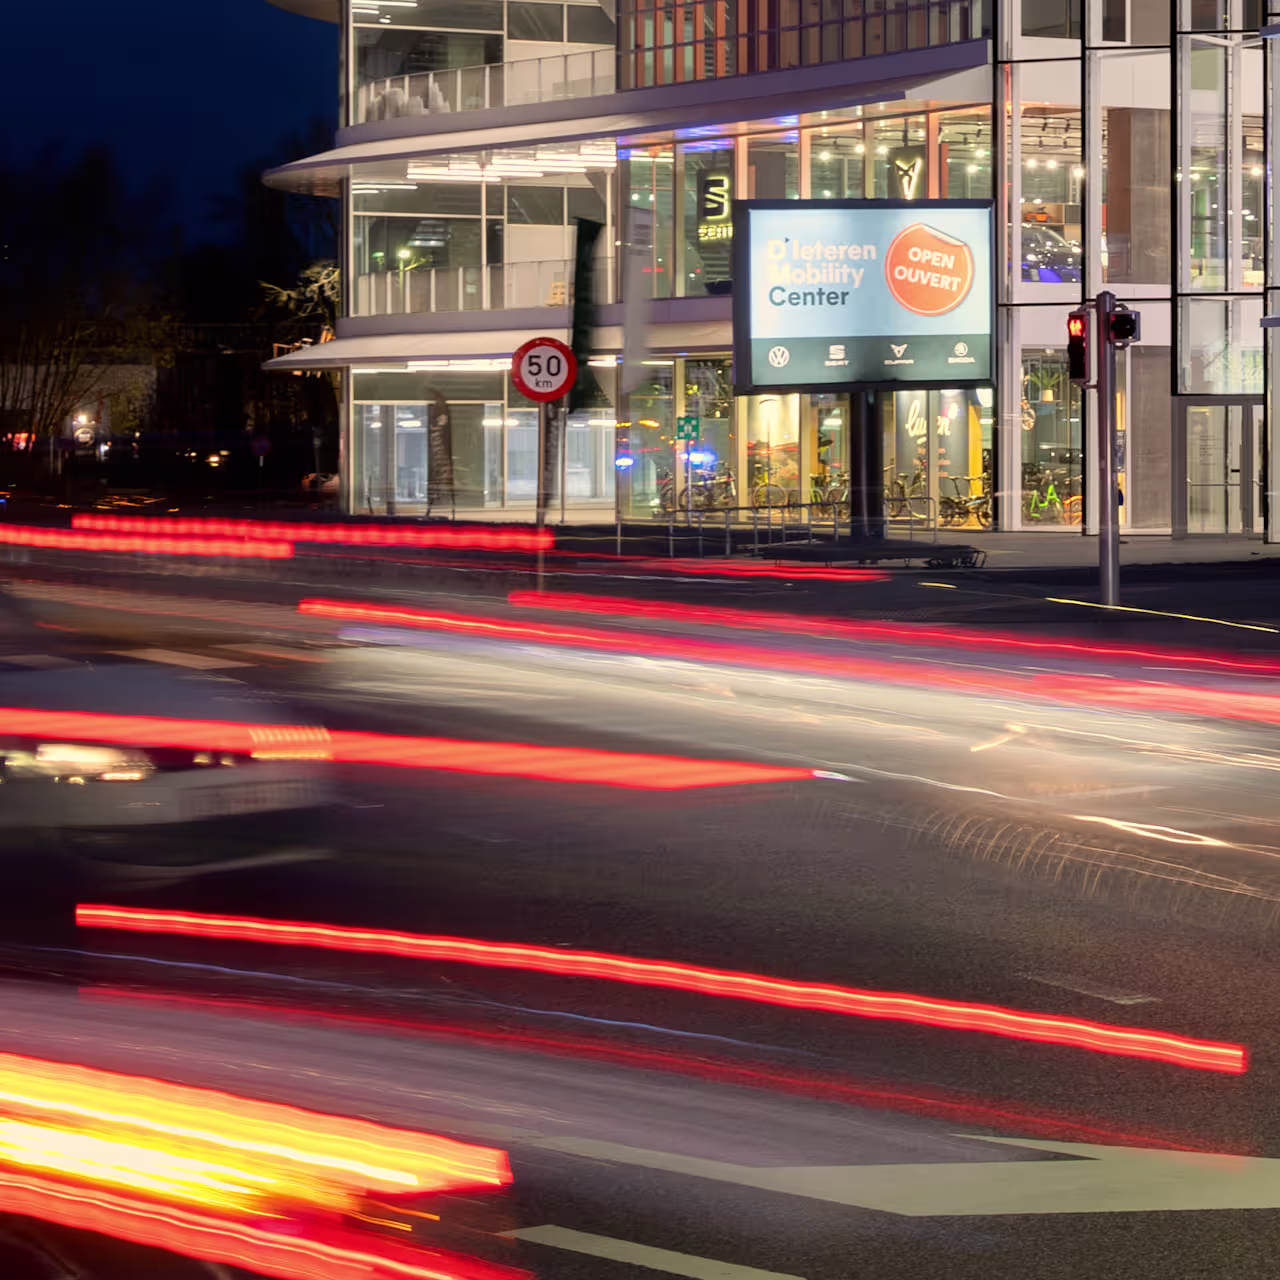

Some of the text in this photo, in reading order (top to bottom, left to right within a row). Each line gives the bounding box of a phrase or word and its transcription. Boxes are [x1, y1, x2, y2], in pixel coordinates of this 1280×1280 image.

[908, 246, 956, 270] OPEN
[767, 263, 865, 289] Mobility
[894, 265, 962, 292] OUVERT
[768, 286, 850, 307] Center
[528, 354, 561, 377] 50
[535, 377, 553, 388] km
